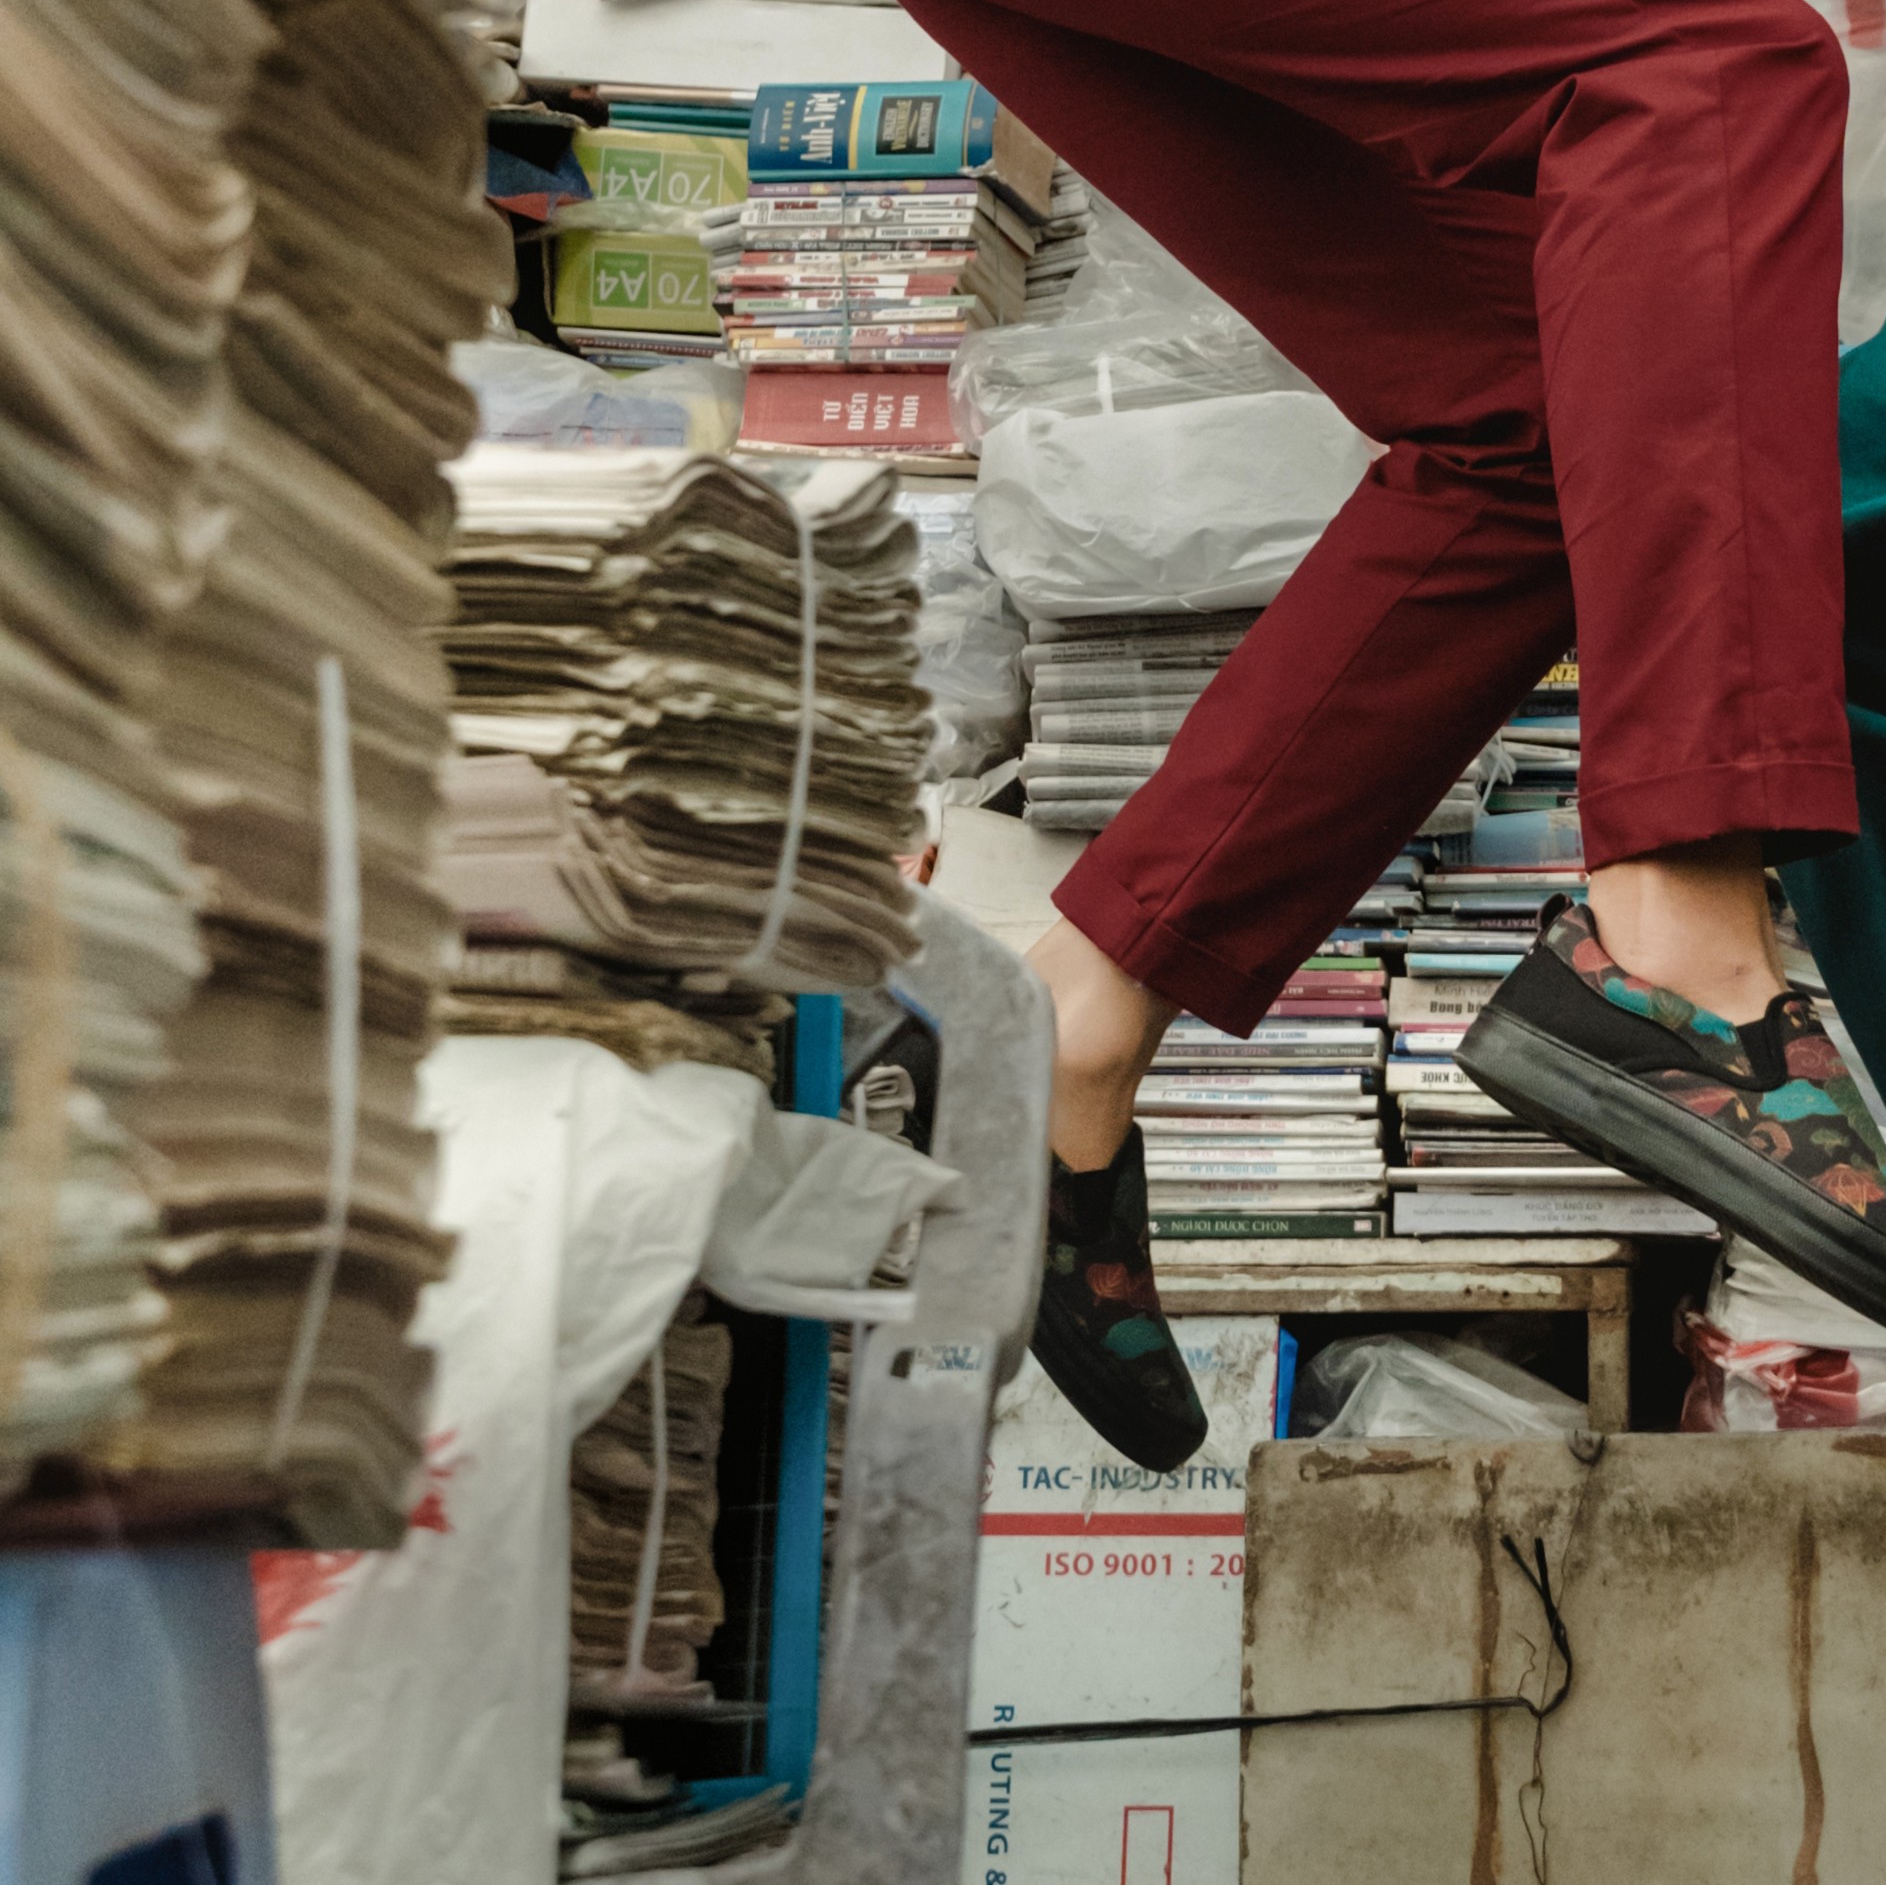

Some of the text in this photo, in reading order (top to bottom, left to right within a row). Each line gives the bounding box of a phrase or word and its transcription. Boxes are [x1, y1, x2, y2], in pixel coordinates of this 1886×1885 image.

[799, 91, 846, 164] Anh-Việt
[605, 166, 712, 205] 70 A4
[596, 268, 703, 305] 70 A4
[822, 400, 842, 422] TỪ
[899, 395, 920, 428] HOA
[1420, 1071, 1450, 1089] KHỎE
[1252, 1220, 1289, 1232] CHỌN
[1018, 1466, 1083, 1490] TAC-
[1044, 1552, 1094, 1576] ISO
[1104, 1553, 1172, 1576] 9001
[987, 1705, 1014, 1855] RUTING
